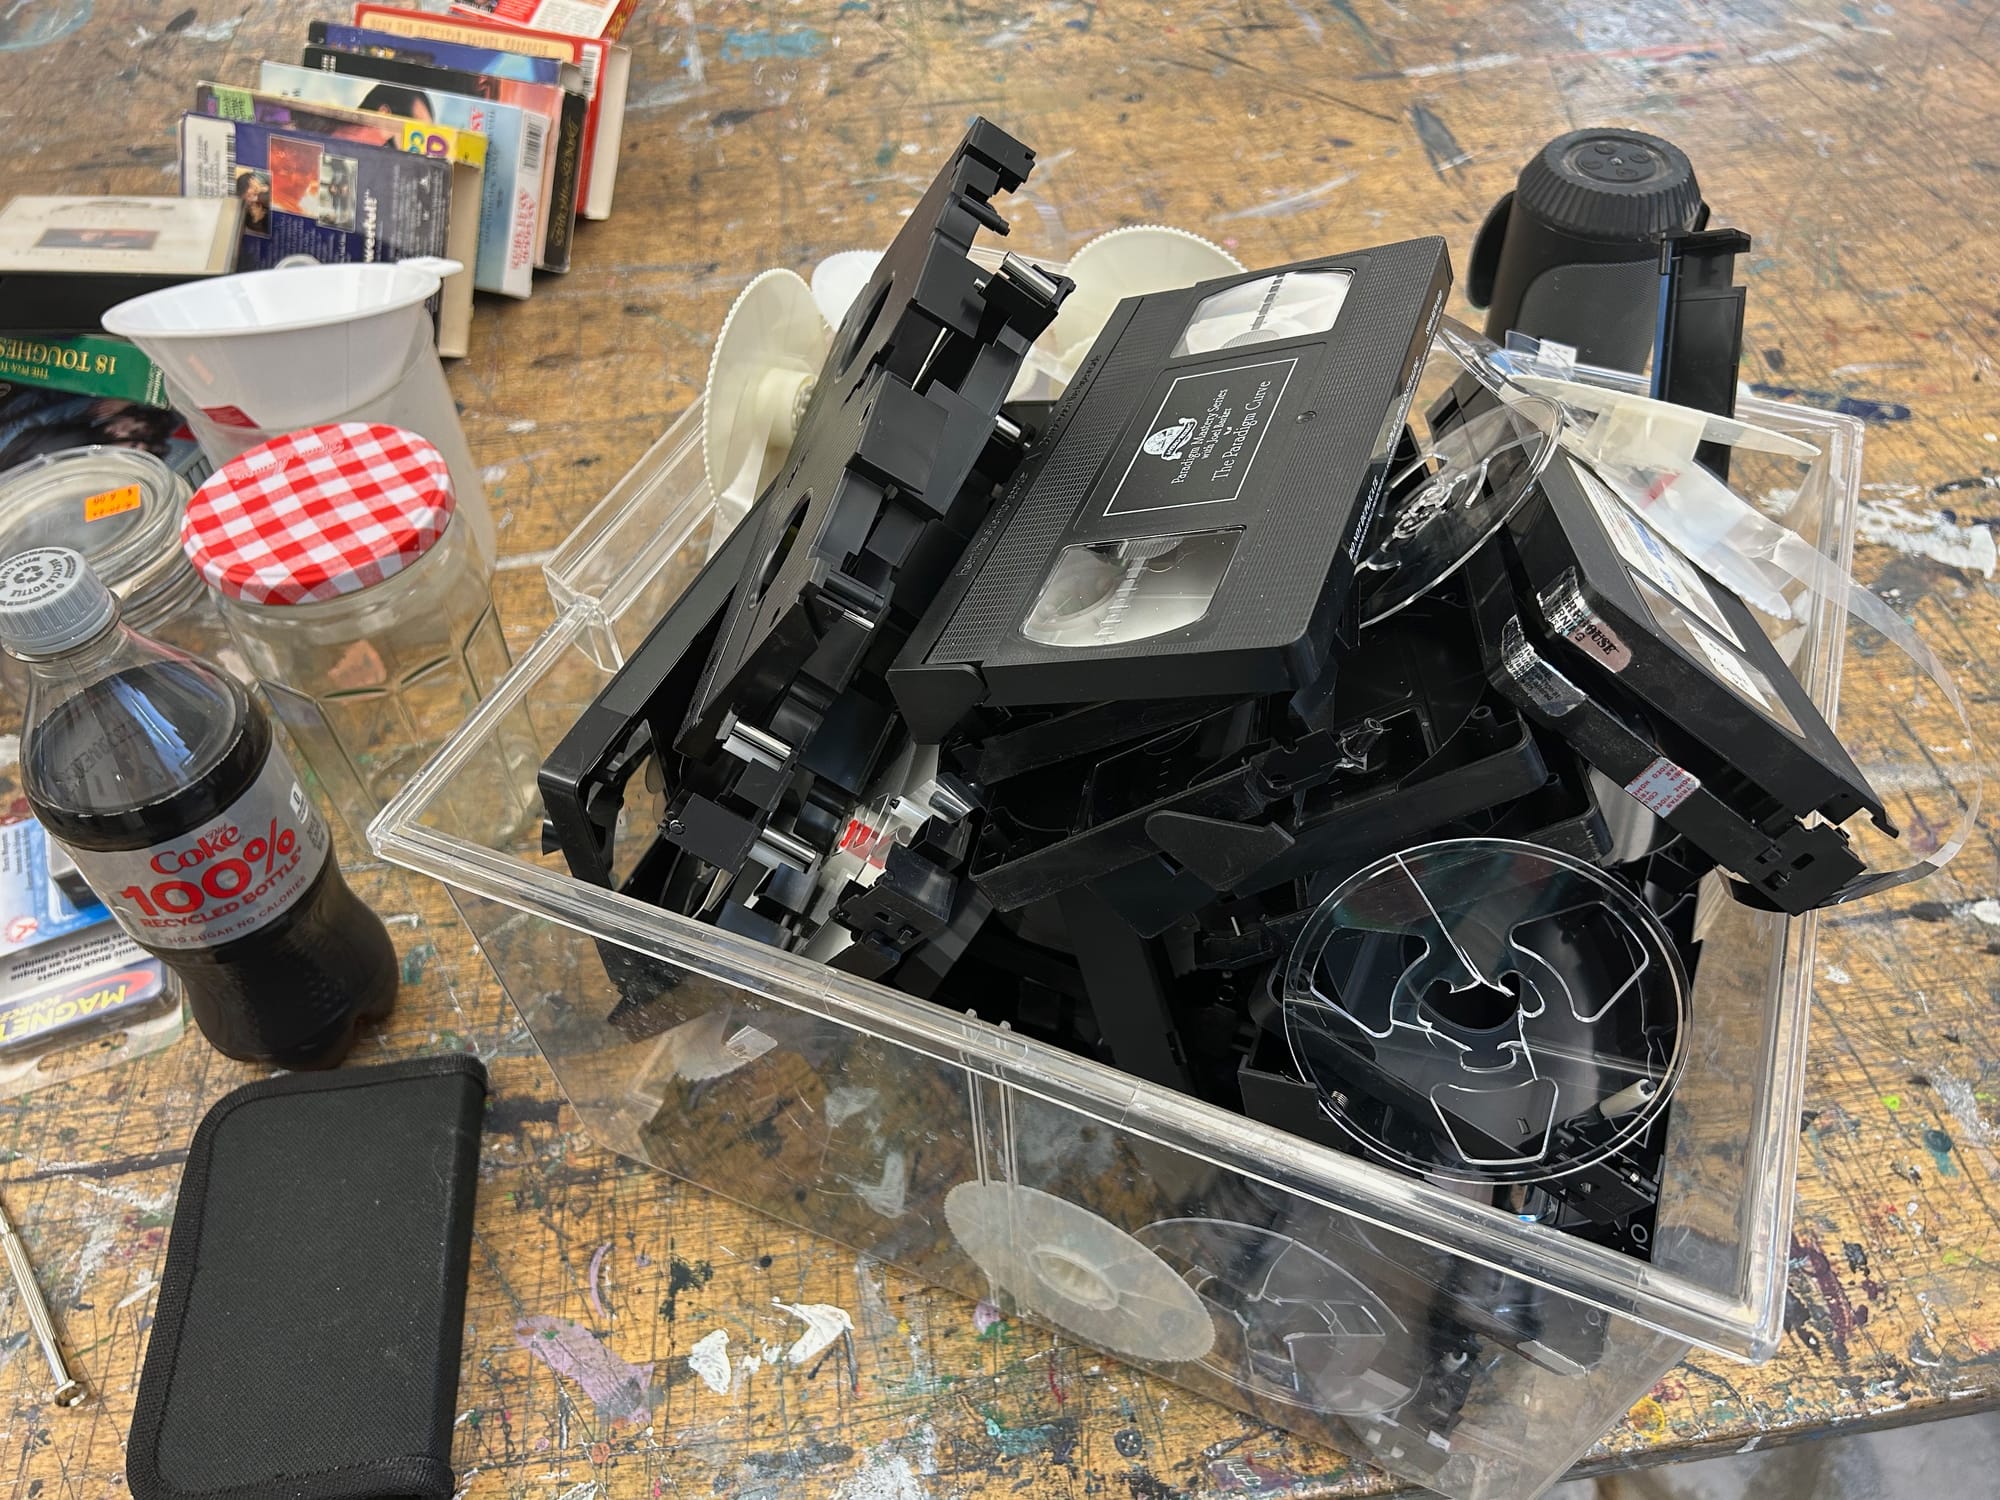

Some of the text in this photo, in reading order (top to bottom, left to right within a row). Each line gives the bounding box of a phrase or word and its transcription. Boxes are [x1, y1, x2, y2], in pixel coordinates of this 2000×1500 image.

[95, 354, 117, 375] 18
[1171, 446, 1201, 484] Paradigm
[1191, 411, 1219, 446] Mastery
[1207, 388, 1228, 413] Series
[1201, 407, 1232, 460] with Joel Barker
[1211, 380, 1271, 481] The Paradigm Curve
[1653, 794, 1672, 812] VIDEO
[1666, 787, 1691, 809] TRISTAR
[120, 816, 296, 917] 100%
[150, 826, 243, 875] Coke
[139, 901, 240, 929] RECYCLED
[167, 875, 307, 945] NO SUGAR NO CALORIES
